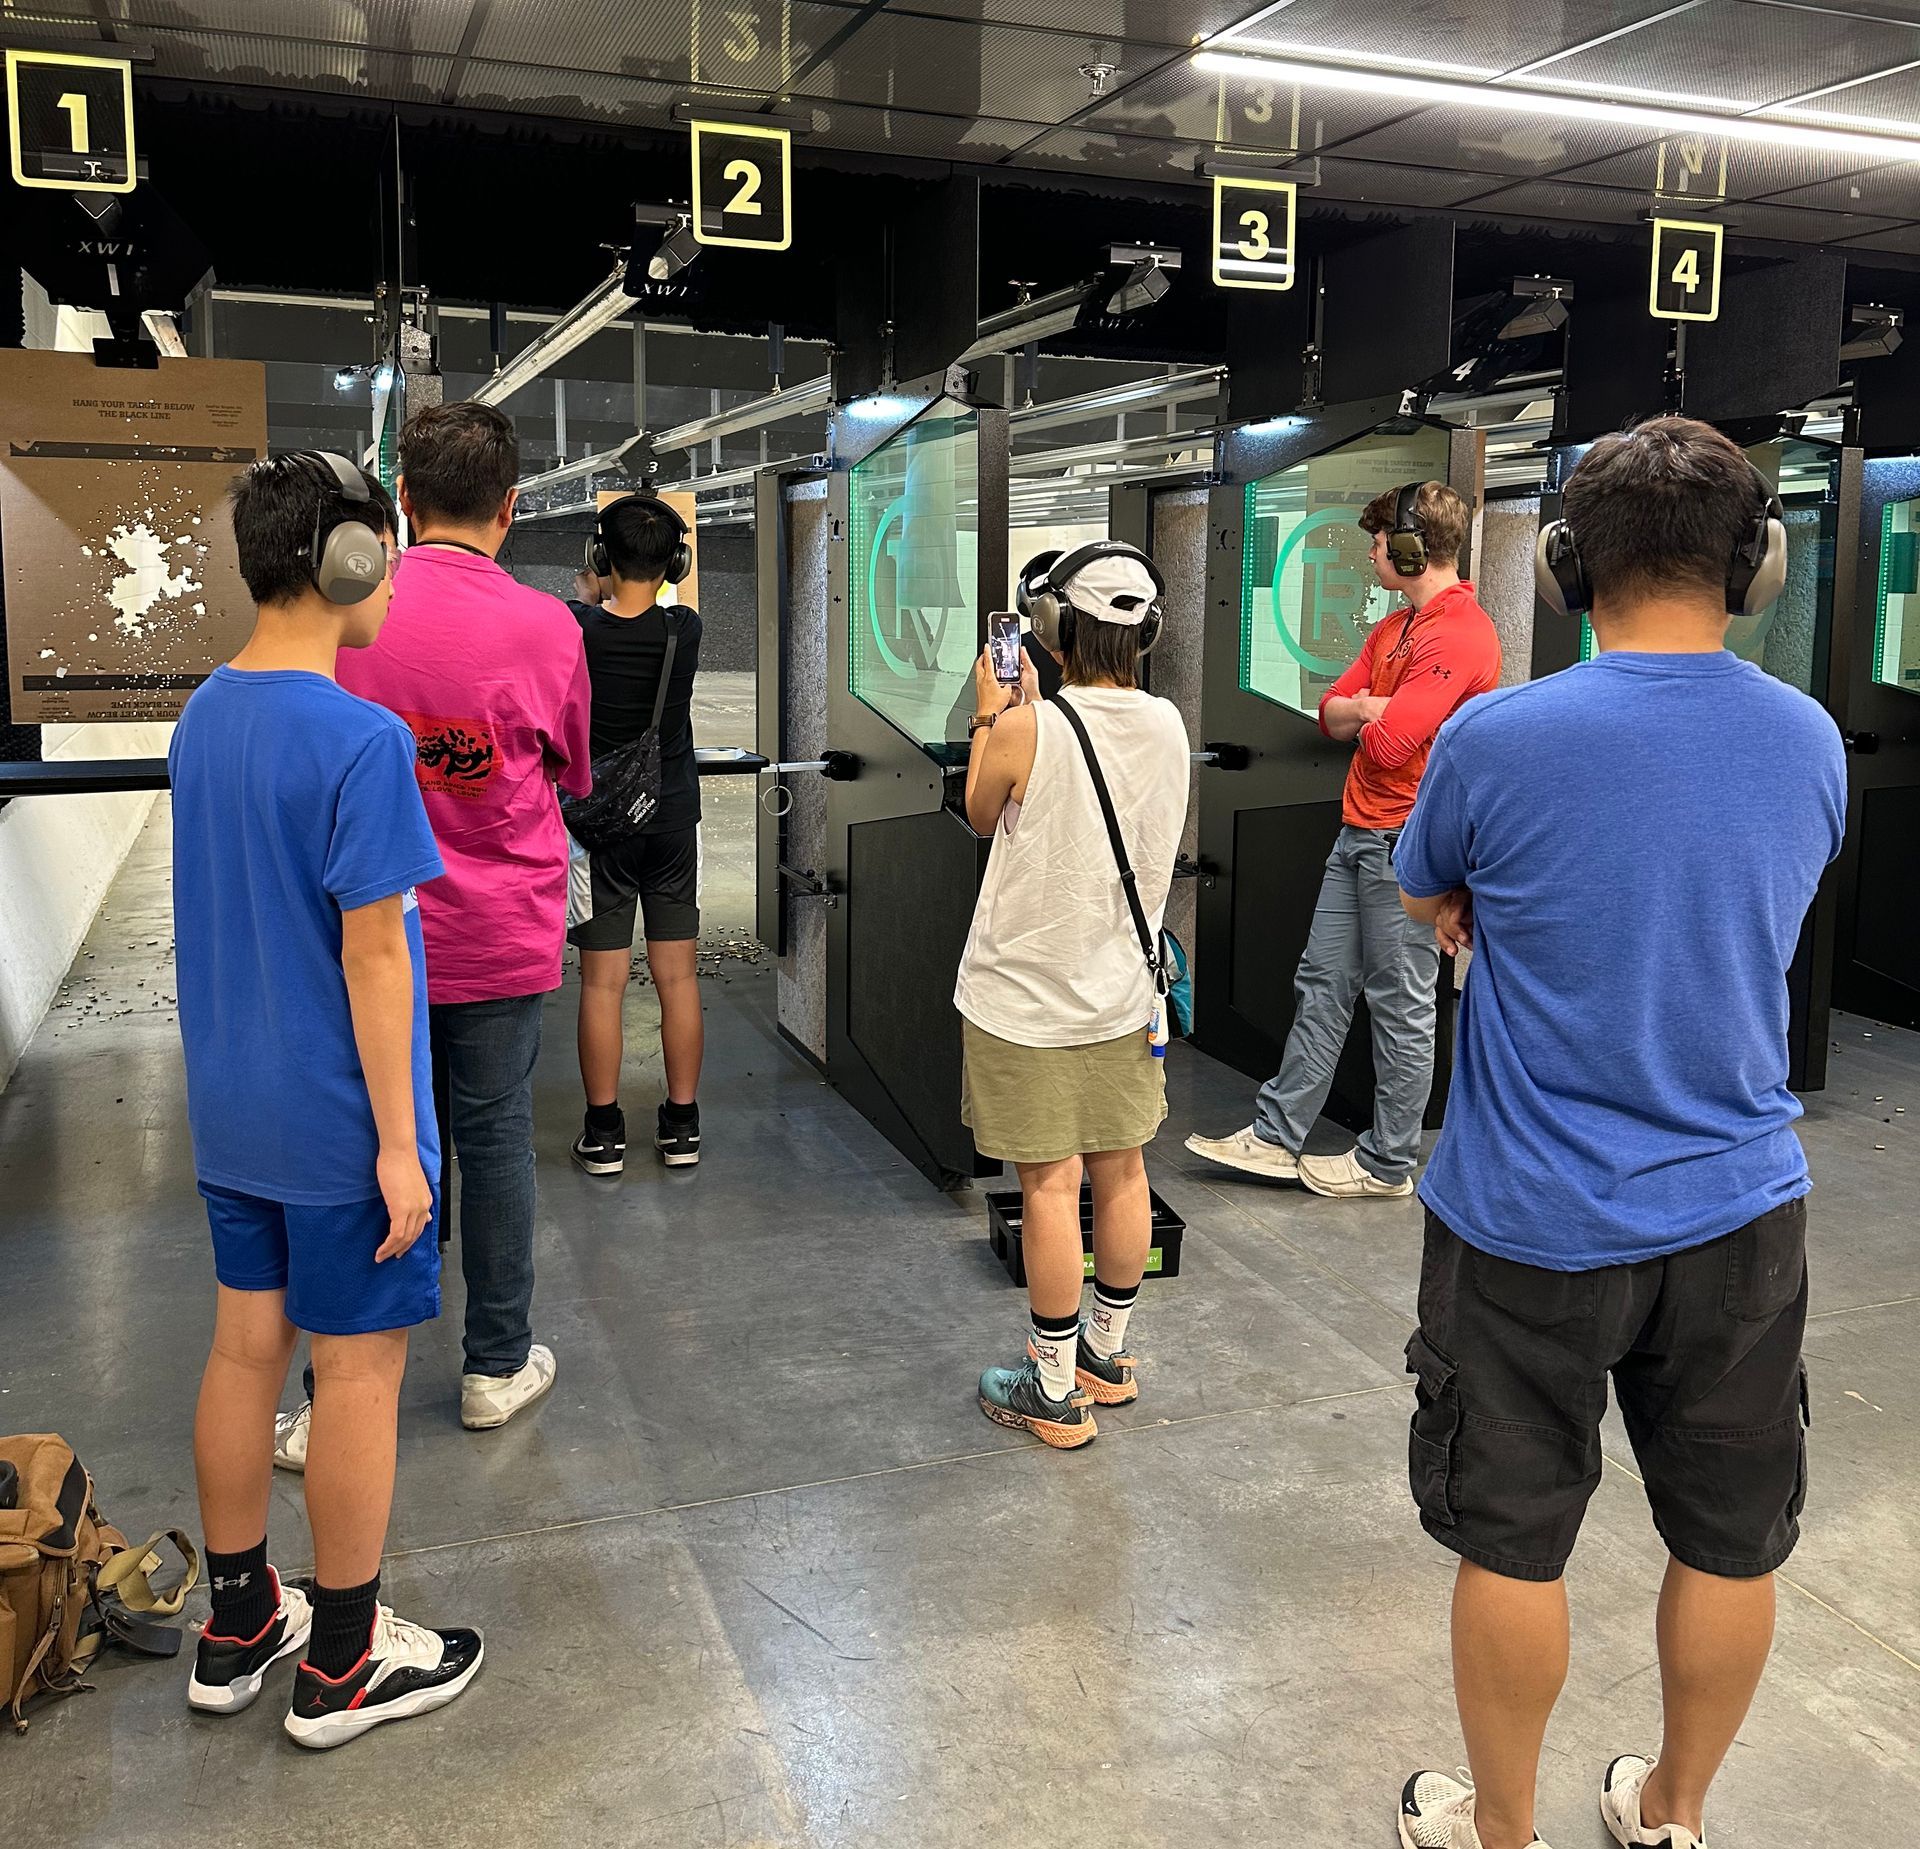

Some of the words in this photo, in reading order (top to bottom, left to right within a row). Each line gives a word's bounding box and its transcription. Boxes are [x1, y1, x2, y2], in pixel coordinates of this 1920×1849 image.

[57, 92, 90, 153] 1
[723, 159, 762, 216] 2
[1237, 210, 1270, 261] 3
[1671, 249, 1700, 294] 4
[1451, 357, 1479, 381] 4
[72, 399, 98, 408] HANG
[100, 400, 125, 409] YOUR
[127, 401, 162, 410] TARGET
[164, 403, 195, 411] BELOW
[98, 410, 117, 418] THE
[119, 411, 148, 419] BLACK
[150, 412, 171, 420] LINE
[648, 461, 659, 473] 3
